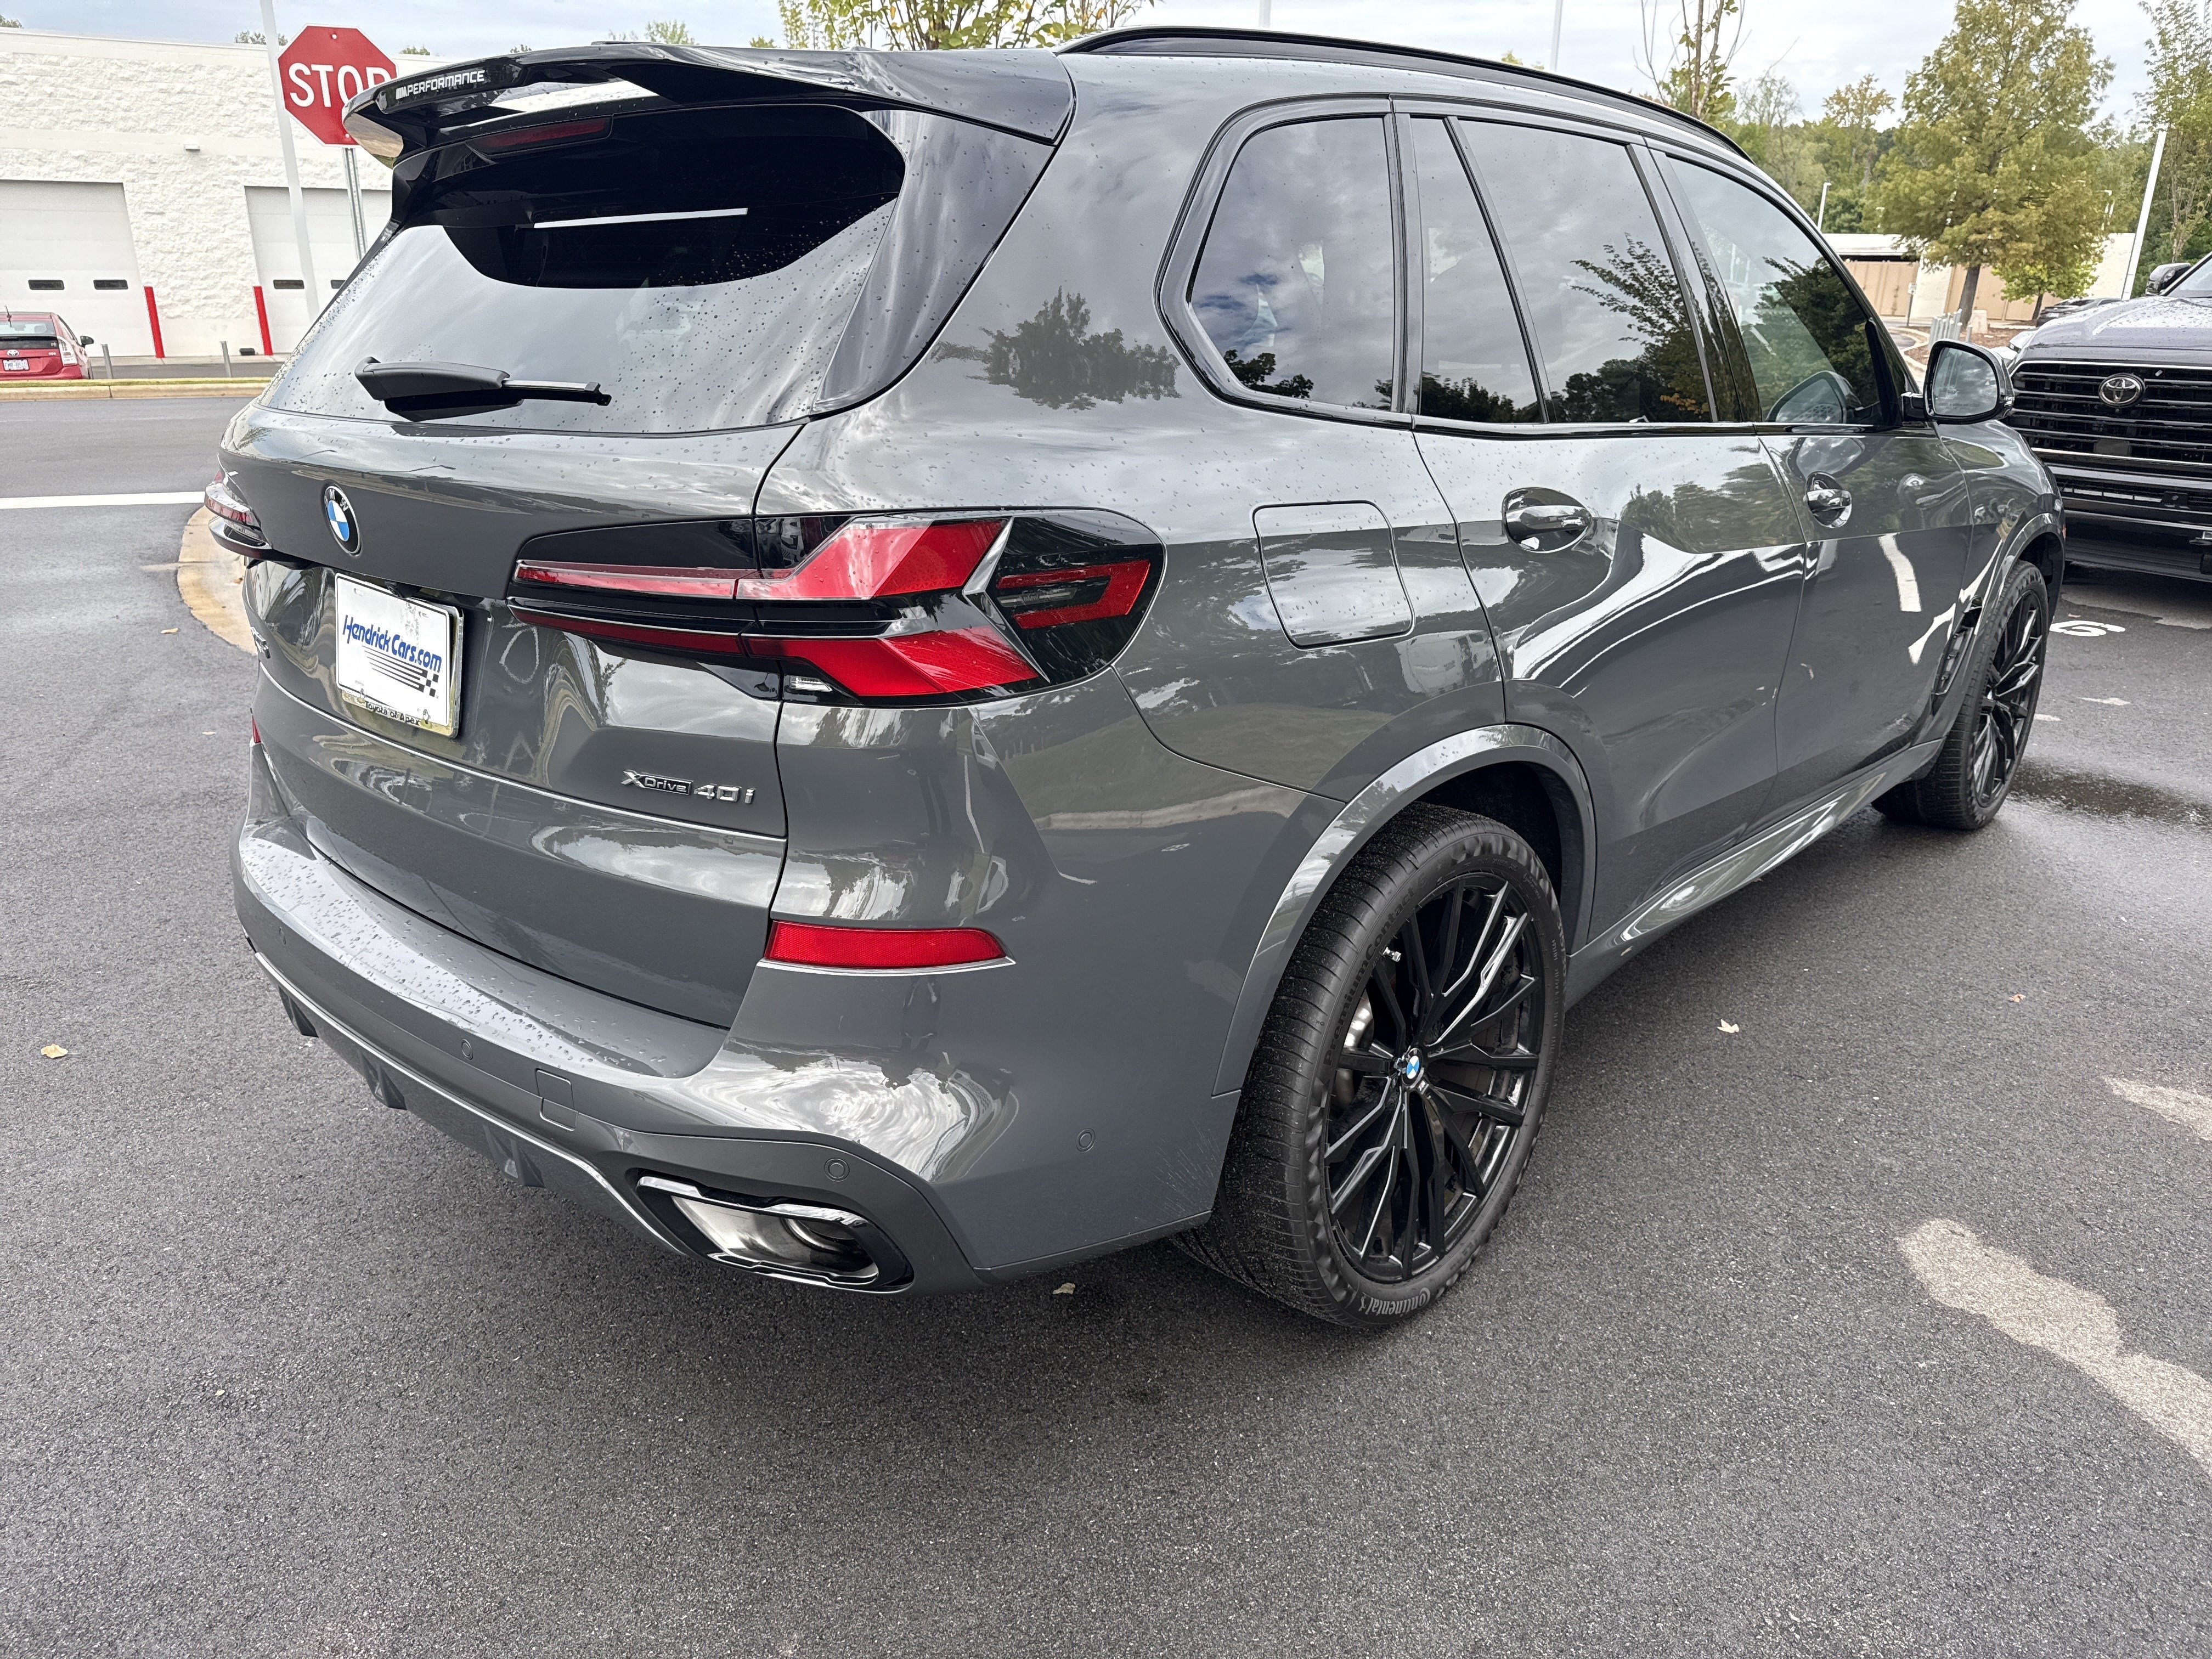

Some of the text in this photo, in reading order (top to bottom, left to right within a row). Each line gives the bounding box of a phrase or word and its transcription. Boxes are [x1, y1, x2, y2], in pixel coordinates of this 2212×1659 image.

[407, 70, 485, 97] PERFORMANCE
[364, 700, 388, 716] Toyota
[390, 710, 398, 719] of
[1364, 1287, 1431, 1317] Continental
